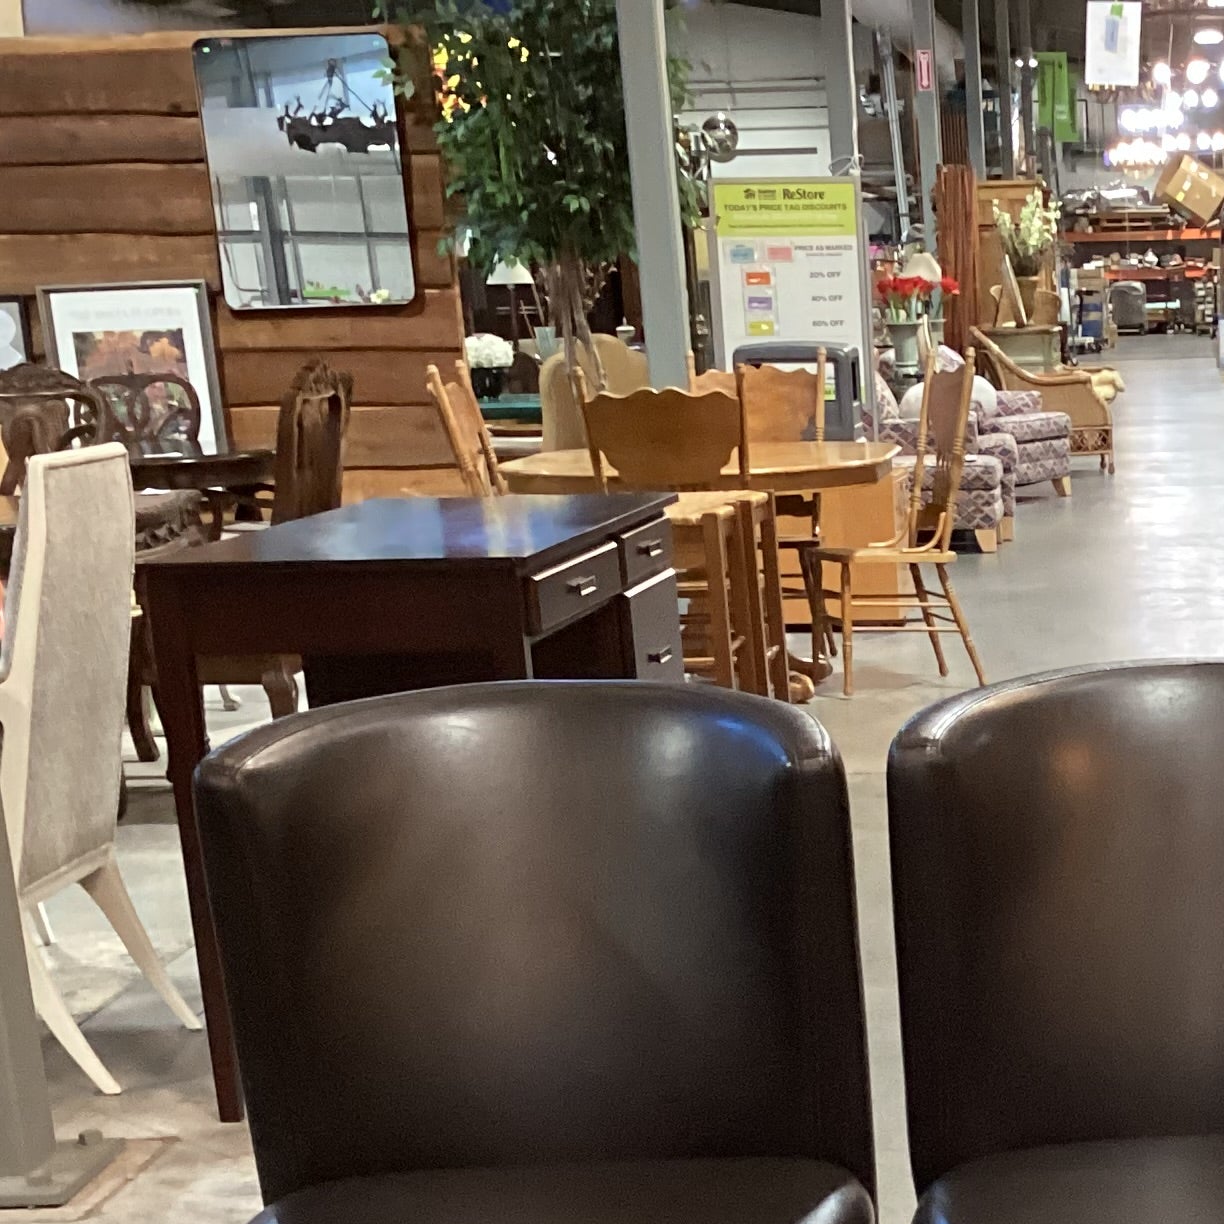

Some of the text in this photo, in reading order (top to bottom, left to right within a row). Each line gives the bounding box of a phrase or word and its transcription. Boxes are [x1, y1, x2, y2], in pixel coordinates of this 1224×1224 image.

[782, 188, 825, 200] ReStore
[759, 203, 782, 211] PRICE
[784, 203, 800, 211] TAG
[801, 203, 847, 211] DISCOUNTS
[829, 319, 844, 327] OFF
